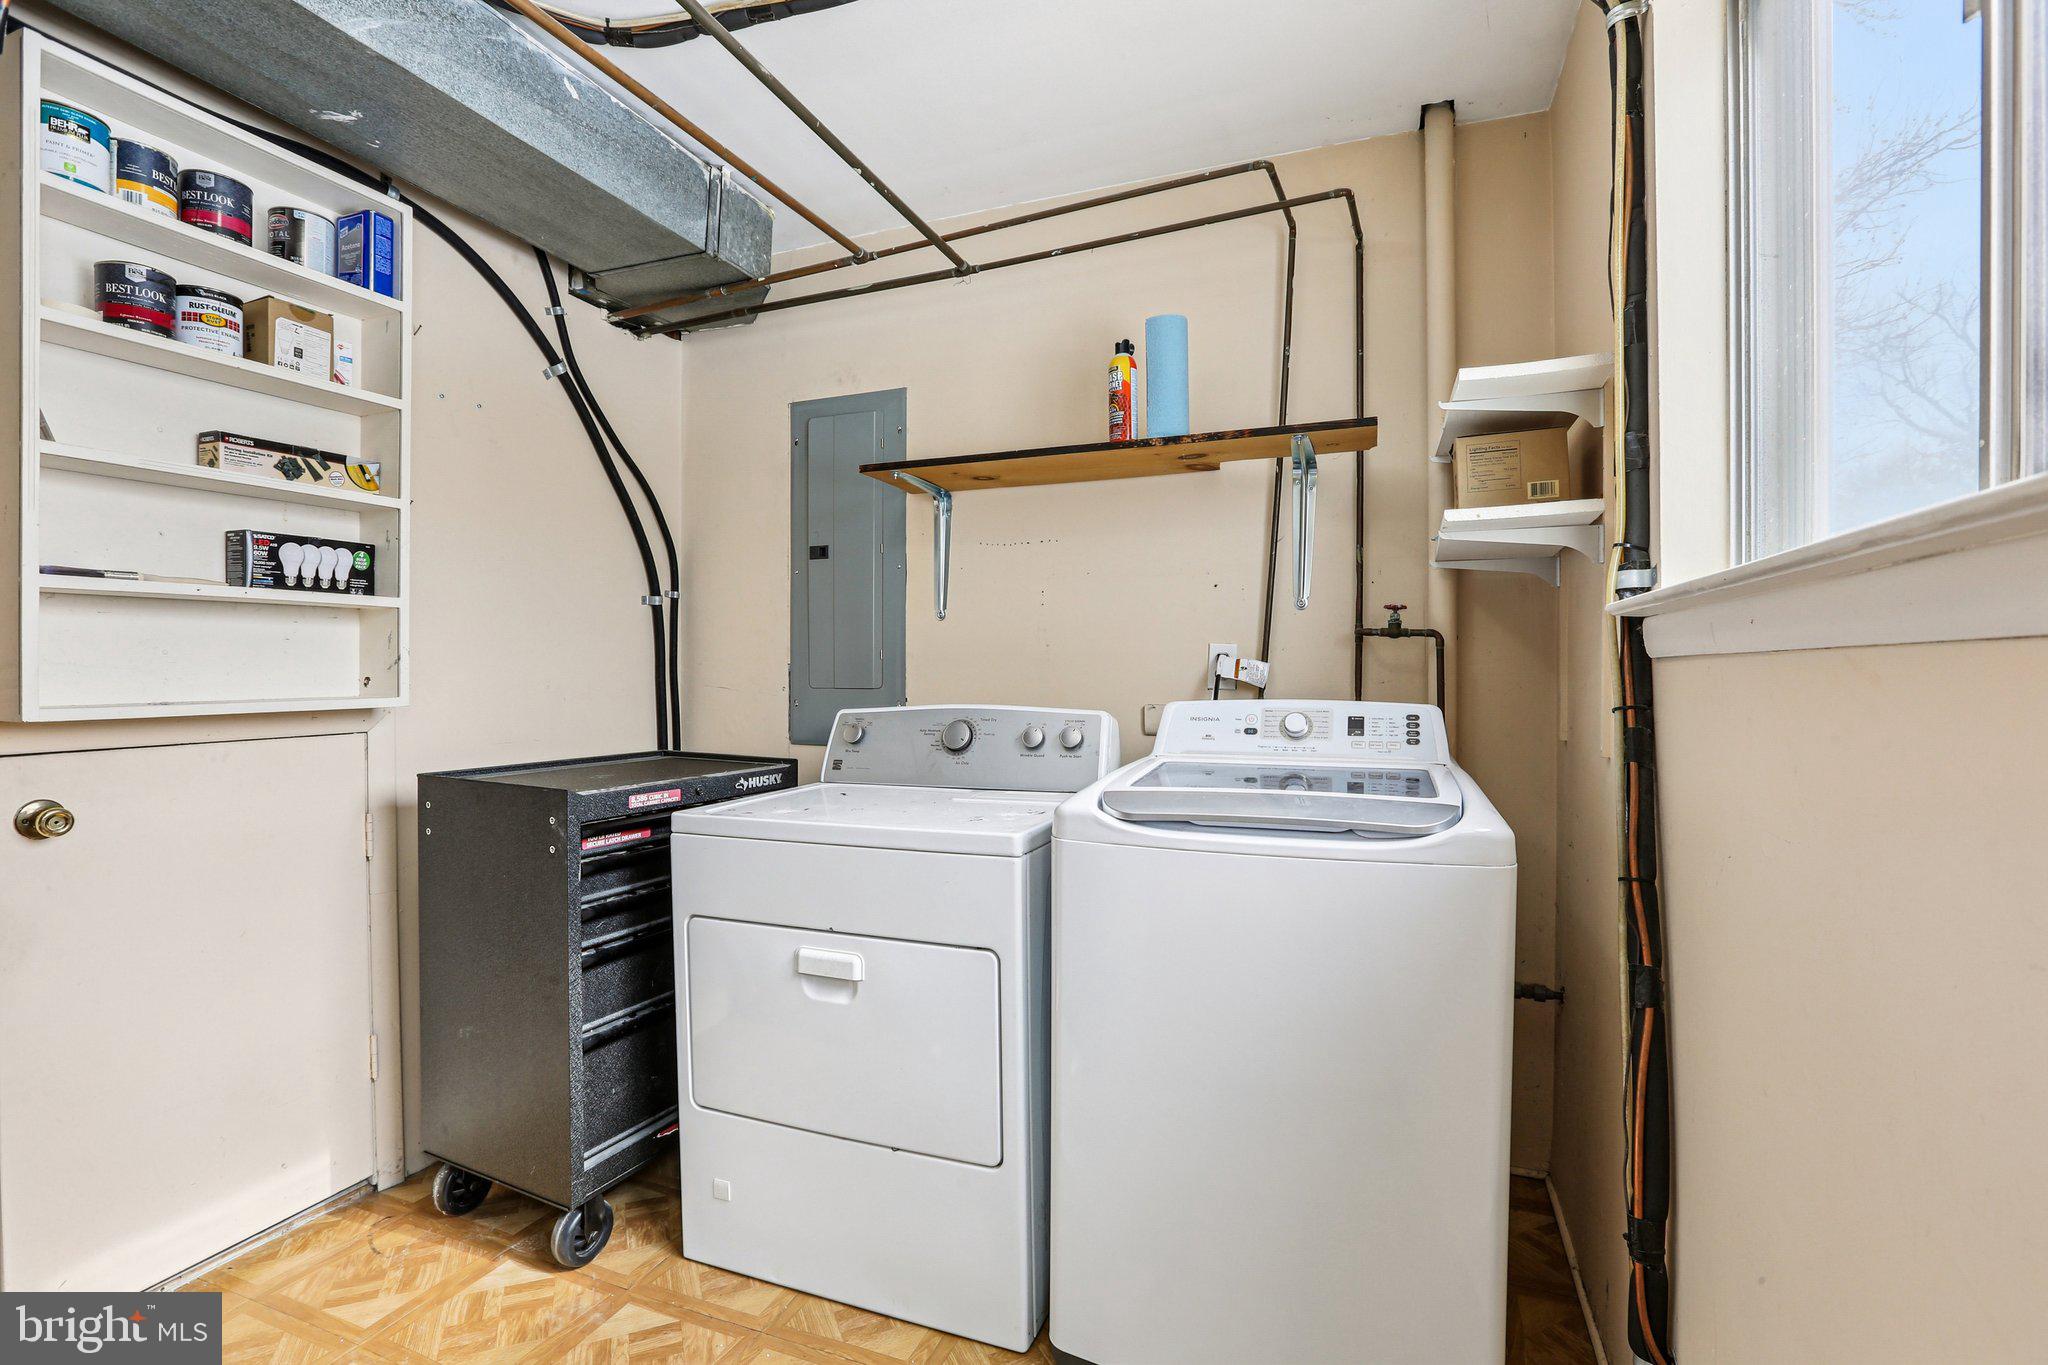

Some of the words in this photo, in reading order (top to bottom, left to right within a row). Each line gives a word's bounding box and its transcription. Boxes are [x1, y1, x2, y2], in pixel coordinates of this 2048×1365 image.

[50, 116, 78, 132] BEHR
[45, 139, 64, 149] PAINT
[152, 169, 174, 189] BEST
[182, 189, 206, 201] BEST
[204, 191, 236, 209] LOOK
[269, 230, 290, 238] OTAL
[341, 242, 361, 251] Acetone
[105, 283, 134, 295] BEST
[135, 286, 167, 304] LOOK
[188, 301, 237, 319] RUST-OLEUM
[181, 325, 219, 334] PROTECTIVE
[1109, 371, 1123, 382] ASP
[229, 436, 255, 447] ROBERTS
[242, 449, 266, 457] Installation
[253, 538, 271, 546] LED
[748, 773, 784, 789] HUSKY
[586, 839, 605, 849] SECURE
[605, 836, 622, 845] LATCH
[622, 833, 642, 843] DRAWER
